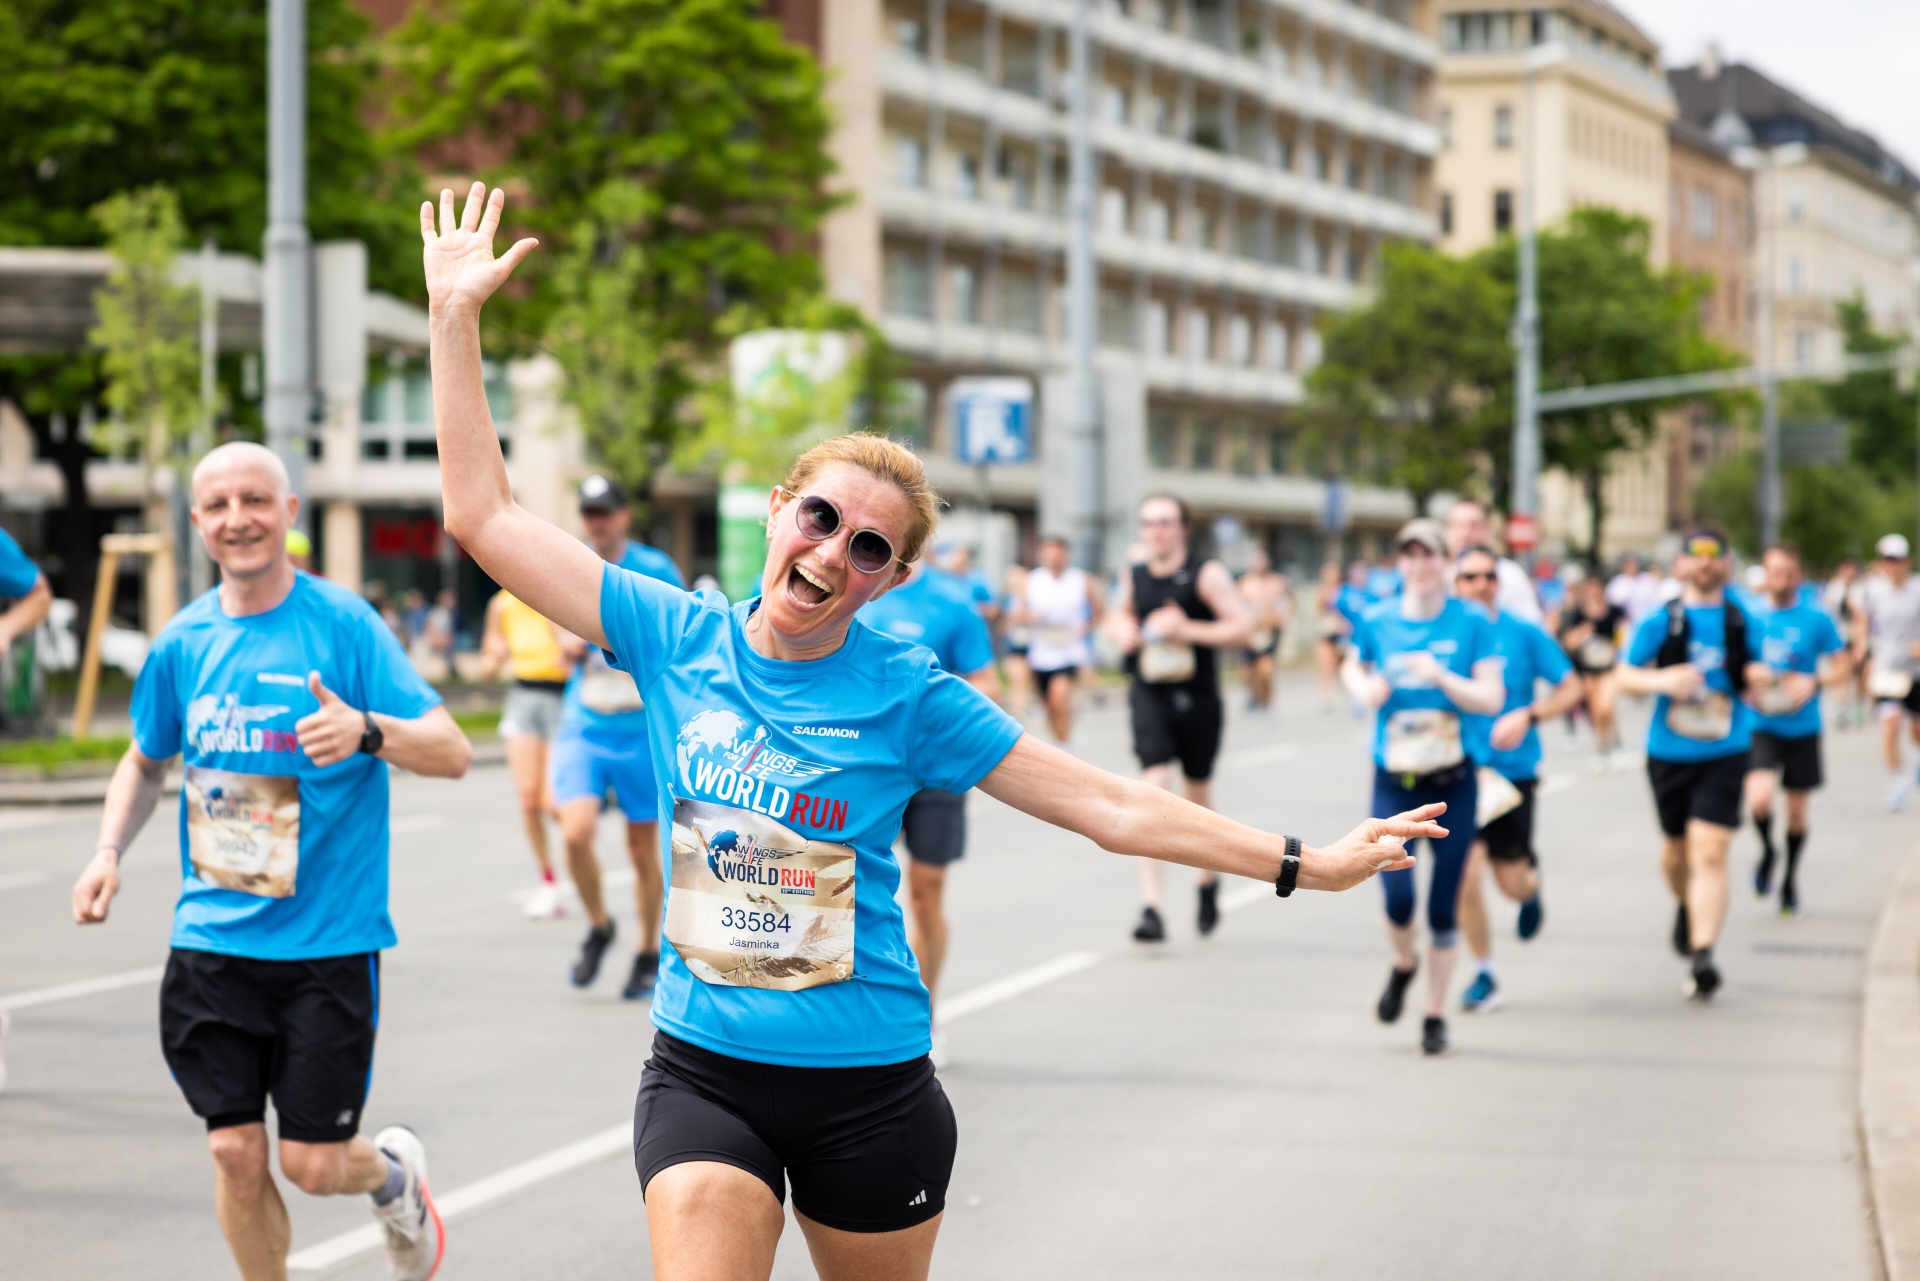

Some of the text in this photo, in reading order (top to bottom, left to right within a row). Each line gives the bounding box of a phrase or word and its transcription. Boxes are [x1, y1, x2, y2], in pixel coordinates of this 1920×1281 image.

[201, 728, 298, 754] WORLD RUN
[792, 725, 860, 740] SALOMON
[722, 751, 776, 781] FOR LIFE
[732, 738, 798, 774] WINGS
[695, 757, 849, 832] WORLD RUN
[737, 844, 778, 859] WINGS
[741, 855, 766, 867] LIFE
[722, 860, 816, 889] WORLD RUN
[721, 906, 791, 933] 33584
[729, 936, 780, 950] Jasminka
[835, 963, 847, 980] 3
